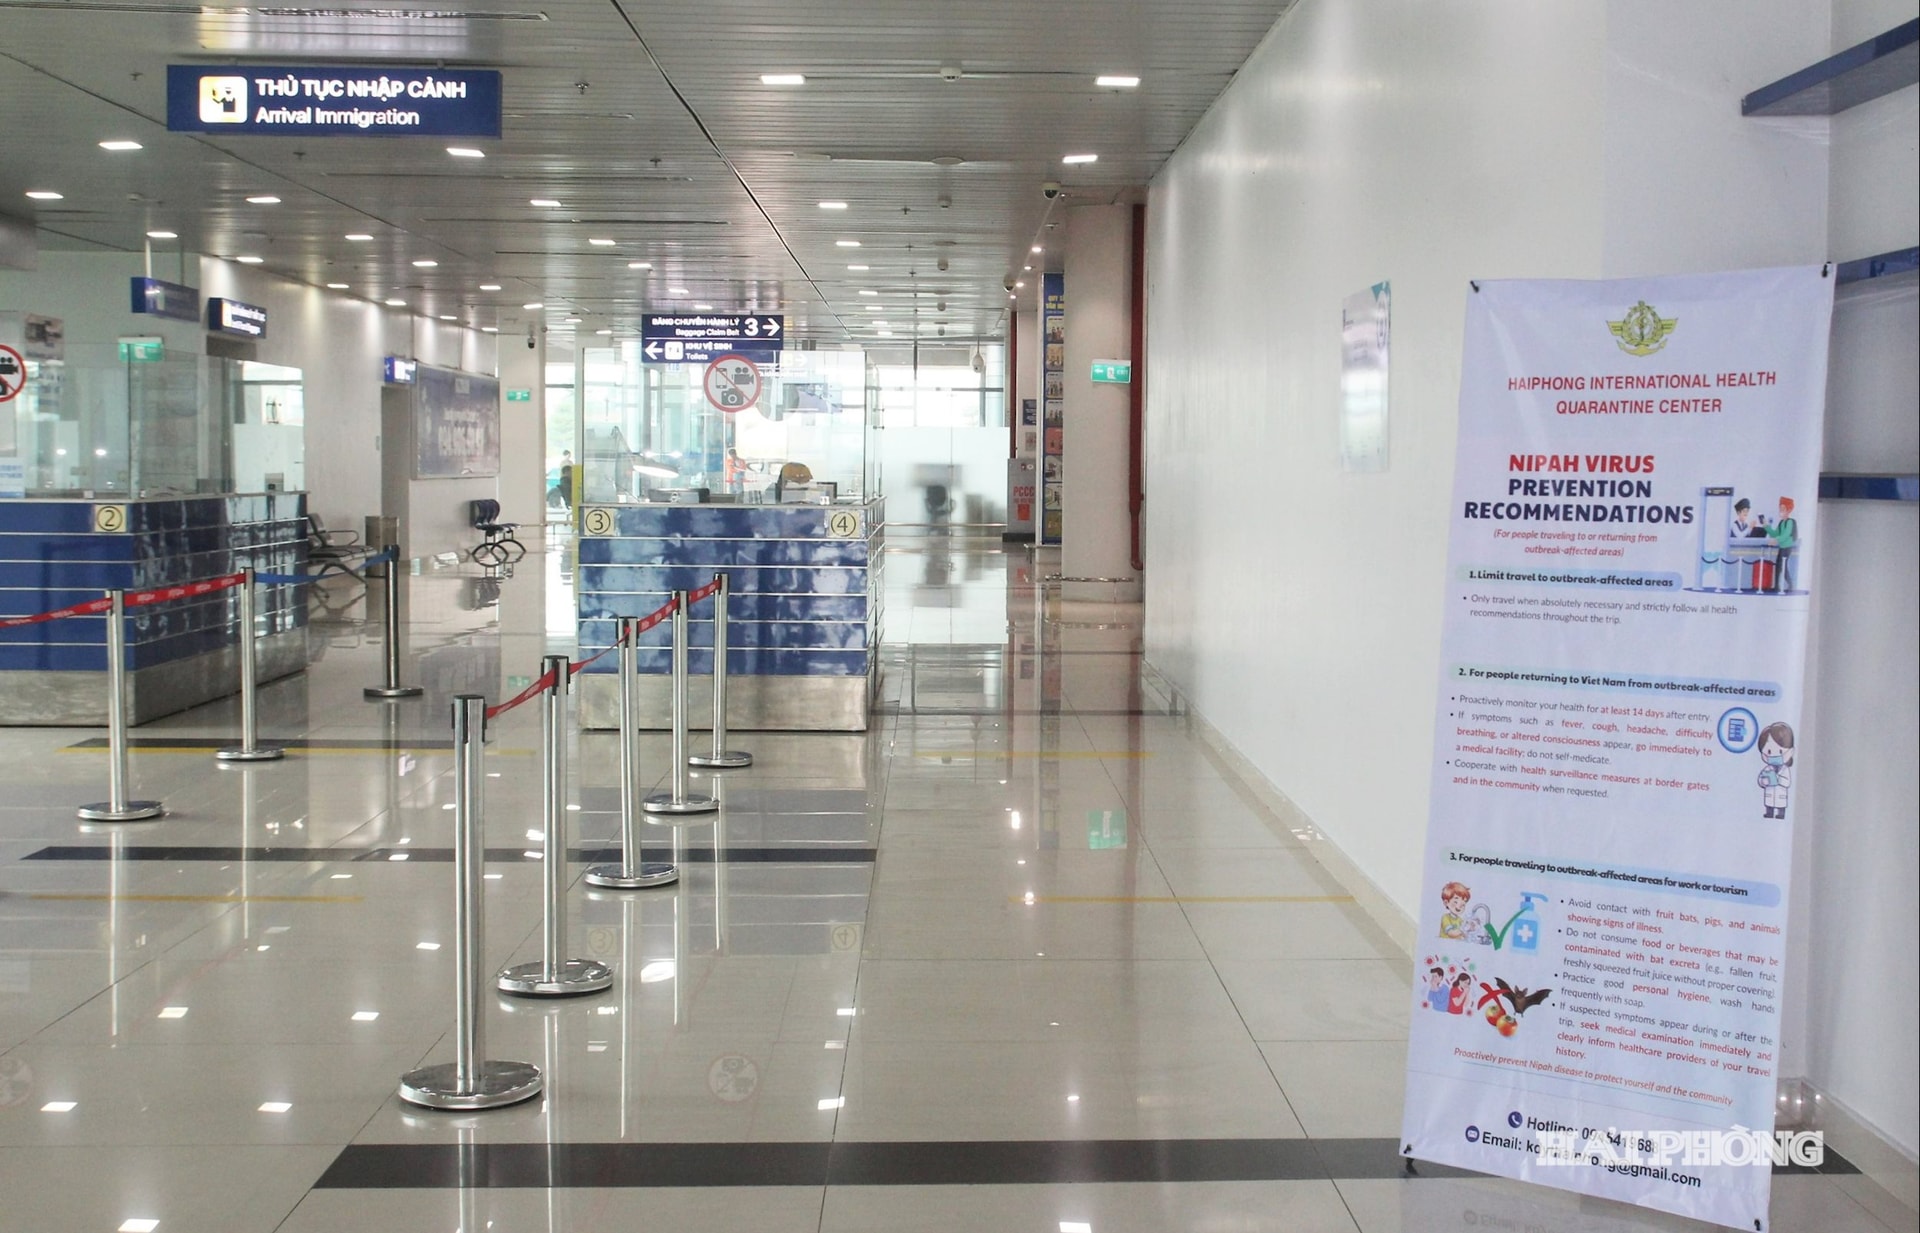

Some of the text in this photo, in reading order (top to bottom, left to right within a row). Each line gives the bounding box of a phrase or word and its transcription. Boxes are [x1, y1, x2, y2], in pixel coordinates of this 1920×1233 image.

[254, 74, 466, 102] THỦ TỤC NHẬP CẢNH
[256, 107, 420, 127] Arrival Immigration
[675, 328, 740, 337] Baggage Claim Belt
[744, 318, 759, 336] 3
[1508, 371, 1776, 390] HAIPHONG INTERNATIONAL HEALTH
[1556, 398, 1721, 414] QUARANTINE CENTER
[1509, 454, 1654, 473] NIPAH VIRUS
[1013, 486, 1035, 497] PCCC
[1508, 478, 1651, 497] PREVENTION
[104, 510, 115, 527] 2
[1464, 501, 1693, 523] RECOMMENDATIONS
[594, 513, 604, 531] 3
[836, 515, 849, 532] 4
[1511, 530, 1538, 539] people
[1540, 531, 1575, 541] traveling
[1577, 532, 1586, 540] to
[1597, 533, 1636, 543] returning
[1637, 533, 1657, 542] from
[1524, 545, 1597, 555] outbreak-affected
[1469, 570, 1476, 578] 1.
[1477, 570, 1504, 579] Limit
[1506, 572, 1536, 581] travel
[1537, 573, 1548, 581] to
[1549, 574, 1643, 585] outbreak-affected
[1471, 594, 1489, 603] Only
[1492, 596, 1515, 604] travel
[1541, 598, 1580, 608] absolutely
[1583, 601, 1623, 610] necessary
[1625, 602, 1640, 610] and
[1642, 603, 1670, 612] strictly
[1672, 603, 1697, 612] follow
[1711, 605, 1737, 614] health
[1470, 610, 1603, 623] recommendations throughout the
[1459, 667, 1465, 675] 2.
[1469, 668, 1484, 676] For
[1486, 671, 1519, 680] people
[1520, 673, 1567, 685] returning
[1581, 675, 1600, 685] Viet
[1602, 677, 1626, 686] Nam
[1627, 678, 1652, 688] from
[1654, 682, 1746, 694] outbreak-affected
[1746, 688, 1776, 696] areas
[1459, 694, 1503, 706] Proactively
[1505, 700, 1536, 708] monitor
[1559, 702, 1584, 711] health
[1586, 704, 1598, 712] for
[1610, 706, 1629, 715] least
[1633, 708, 1642, 716] 14
[1645, 709, 1664, 718] days
[1666, 711, 1685, 719] after
[1471, 714, 1511, 722] symptoms
[1675, 728, 1713, 739] difficulty
[1456, 727, 1496, 739] breathing,
[1511, 731, 1540, 741] altered
[1542, 735, 1600, 746] consciousness
[1635, 743, 1646, 752] go
[1649, 745, 1699, 755] immediately
[1462, 745, 1493, 753] medical
[1495, 746, 1524, 757] facility;
[1526, 750, 1537, 758] do
[1454, 758, 1496, 770] Cooperate
[1499, 764, 1517, 772] with
[1520, 766, 1546, 774] health
[1550, 769, 1597, 780] surveillance
[1601, 774, 1640, 783] measures
[1655, 778, 1683, 787] border
[1687, 782, 1709, 790] gates
[1453, 776, 1468, 784] and
[1479, 778, 1492, 786] the
[1494, 781, 1540, 791] community
[1542, 784, 1564, 793] when
[1450, 852, 1456, 860] 3.
[1458, 853, 1472, 862] For
[1473, 857, 1503, 866] people
[1504, 859, 1545, 873] traveling
[1546, 864, 1556, 872] to
[1556, 866, 1637, 877] outbreak-affected
[1637, 876, 1663, 885] areas
[1663, 876, 1676, 886] for
[1678, 881, 1701, 890] work
[1712, 884, 1748, 896] tourism
[1567, 913, 1634, 929] showing signs of
[1568, 898, 1591, 908] Avoid
[1596, 903, 1627, 913] contact
[1656, 909, 1674, 919] fruit
[1679, 912, 1698, 922] bats,
[1728, 921, 1745, 929] and
[1454, 1047, 1496, 1063] Proactively
[1497, 1056, 1527, 1067] prevent
[1529, 1060, 1552, 1071] Nipah
[1554, 1064, 1583, 1076] disease
[1594, 1073, 1622, 1083] protect
[1624, 1079, 1654, 1091] yourself
[1655, 1085, 1671, 1093] and
[1673, 1086, 1687, 1096] the
[1688, 1091, 1732, 1104] community
[1481, 1131, 1522, 1150] Email:
